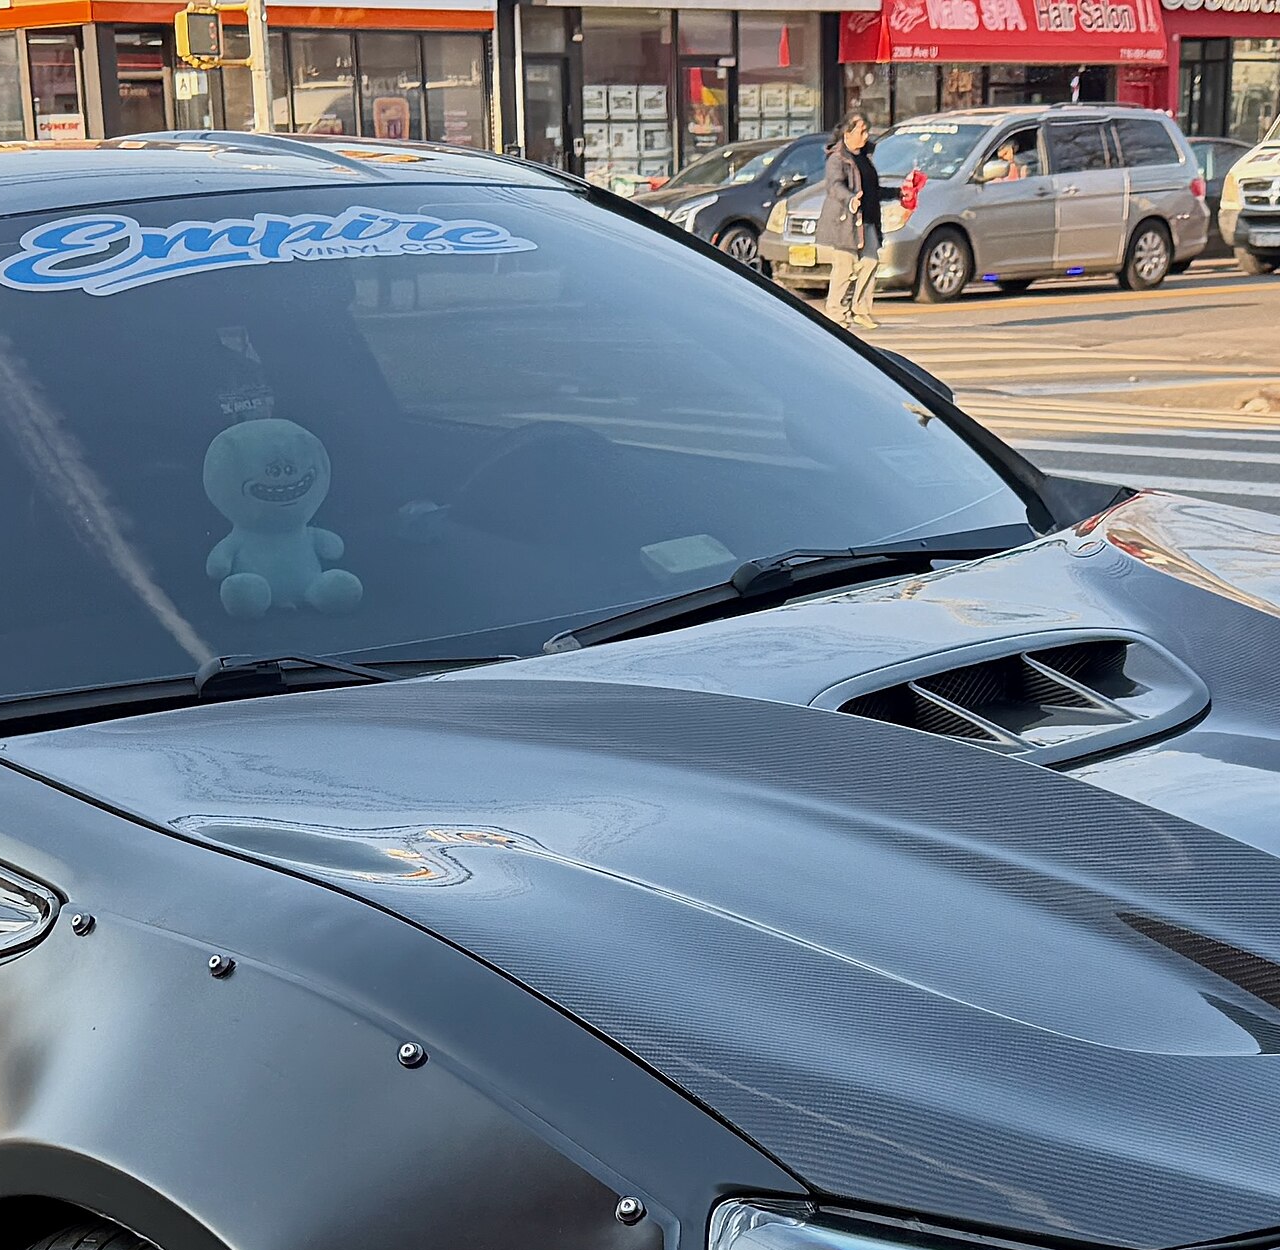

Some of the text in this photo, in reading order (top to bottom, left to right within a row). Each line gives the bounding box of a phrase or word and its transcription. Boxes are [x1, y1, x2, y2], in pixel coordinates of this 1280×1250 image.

[4, 212, 517, 289] Empire
[291, 243, 446, 257] VINYL CO
